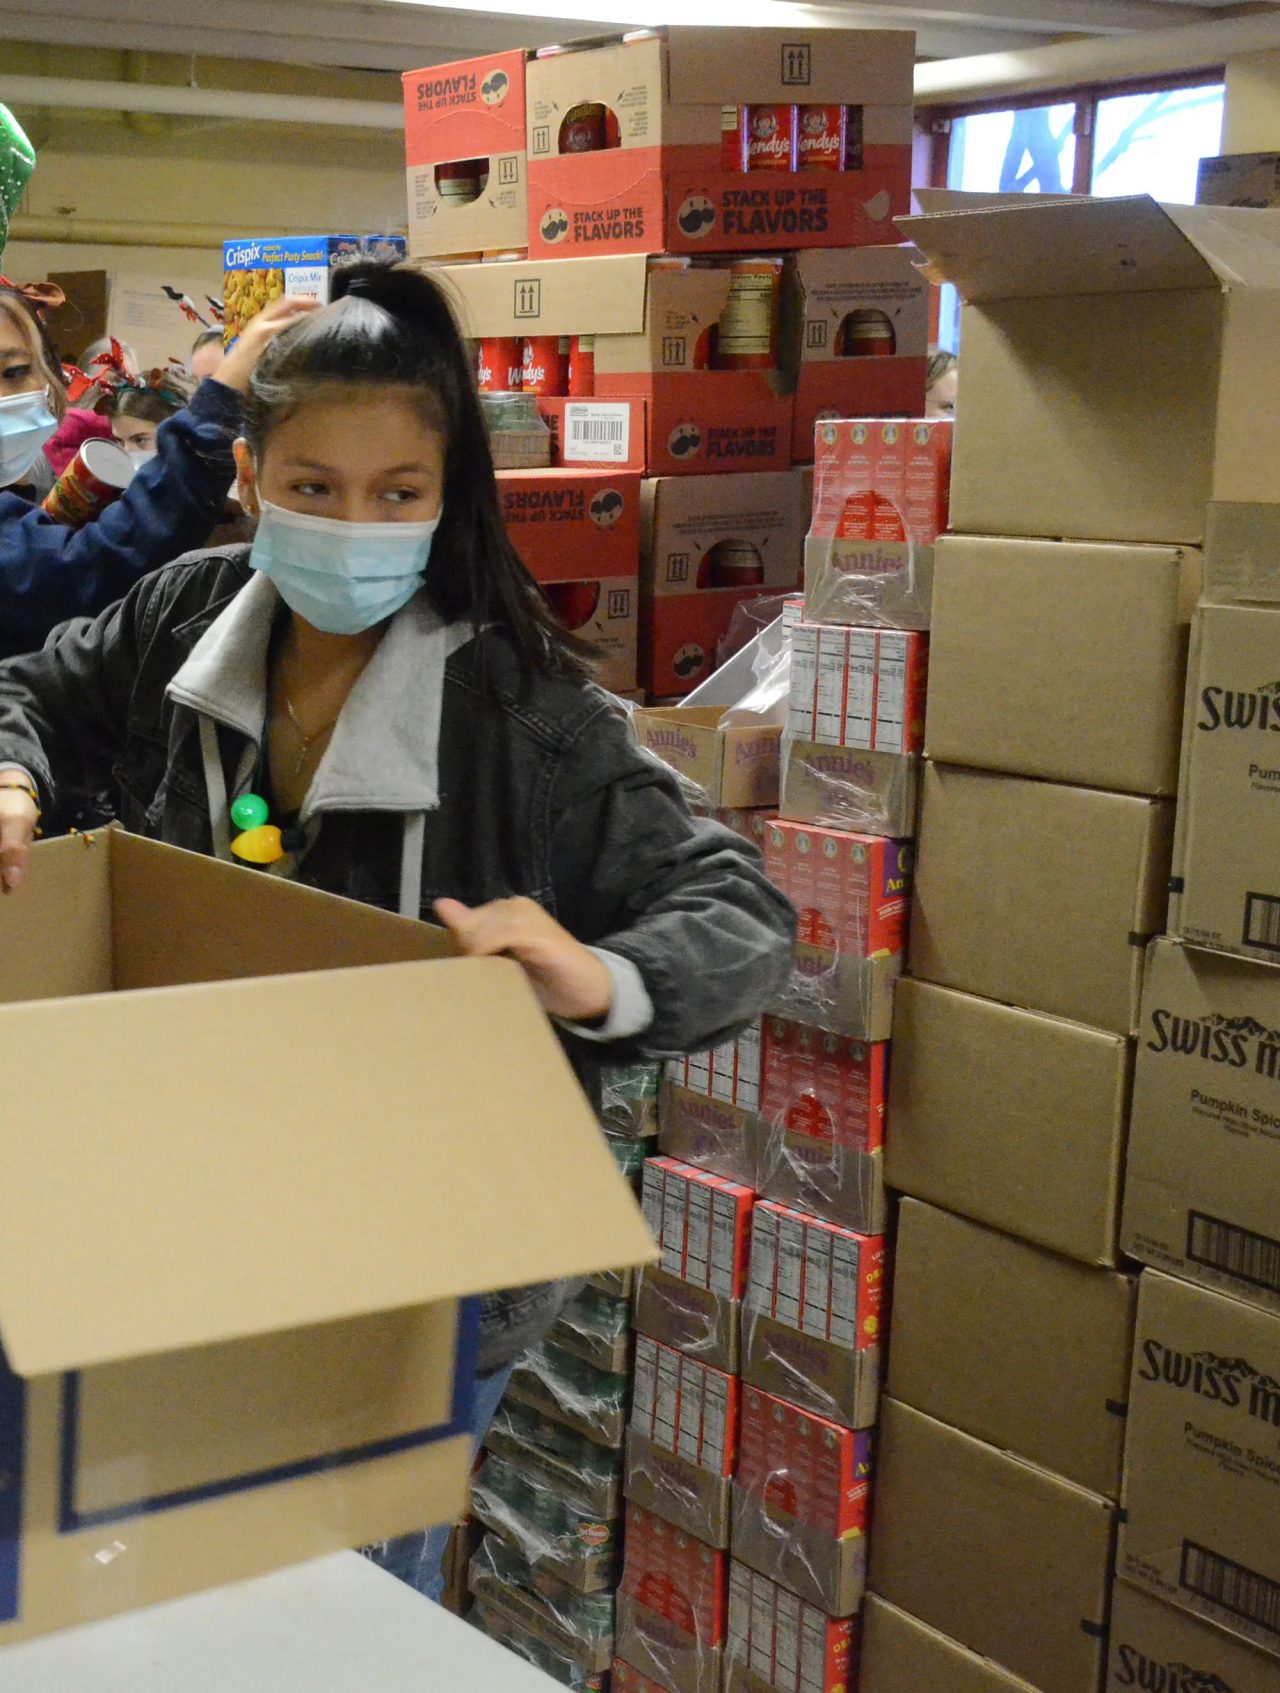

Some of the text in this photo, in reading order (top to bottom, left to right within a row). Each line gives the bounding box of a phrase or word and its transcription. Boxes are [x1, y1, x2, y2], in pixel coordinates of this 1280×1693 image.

[417, 74, 476, 100] FLAVORS
[418, 91, 476, 112] STACK UP THE
[723, 189, 828, 208] STACK UP THE
[574, 207, 644, 226] STACK UP THE
[723, 207, 829, 235] FLAVORS
[574, 220, 645, 242] FLAVORS
[226, 242, 260, 267] Crispix
[262, 252, 284, 265] Perfect
[284, 252, 300, 264] Party
[288, 272, 323, 285] Crispix Mix
[542, 415, 559, 431] HE
[707, 426, 777, 440] STACK UP THE
[707, 438, 776, 458] FLAVORS
[504, 490, 585, 509] FLAVORS
[530, 510, 546, 522] UP
[549, 509, 585, 521] STACK
[1197, 687, 1280, 732] SWIS
[1190, 1088, 1249, 1119] Pumpkin
[1252, 1108, 1280, 1129] Spic
[1184, 1421, 1242, 1456] Pumpkin
